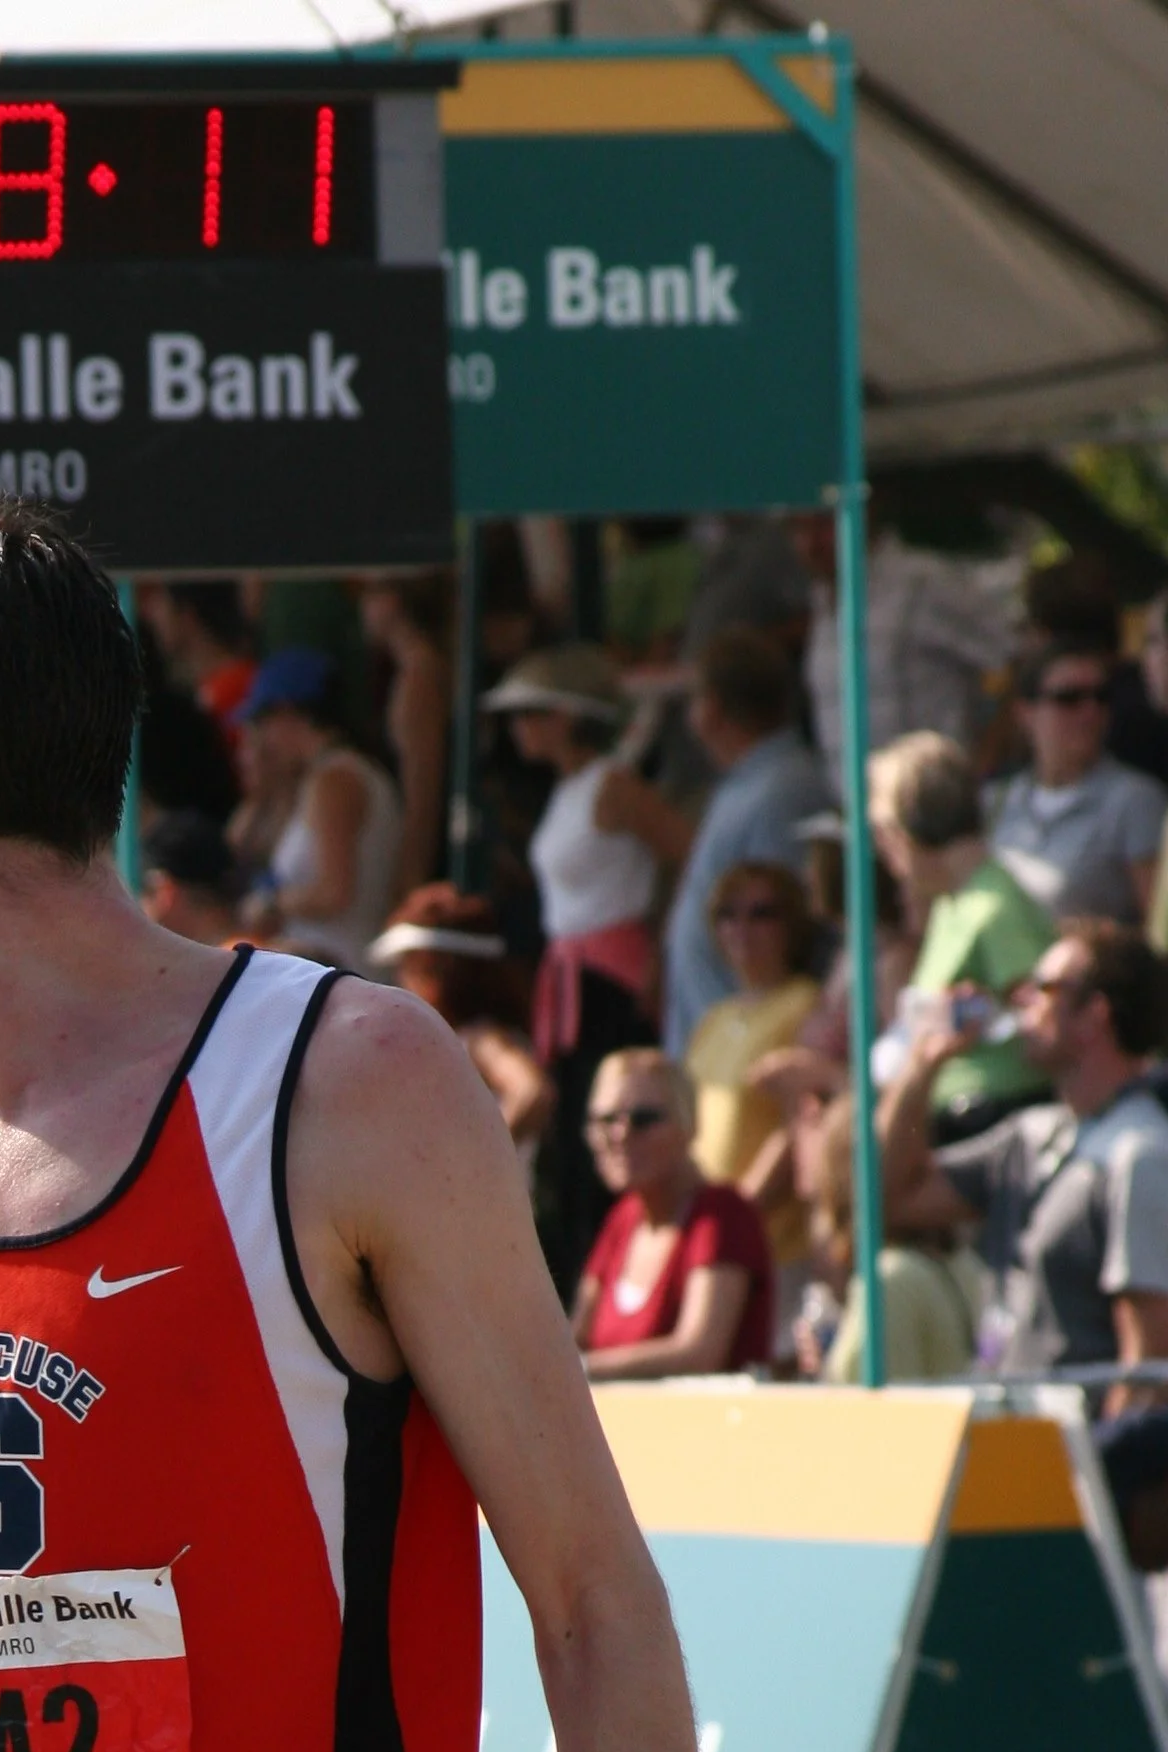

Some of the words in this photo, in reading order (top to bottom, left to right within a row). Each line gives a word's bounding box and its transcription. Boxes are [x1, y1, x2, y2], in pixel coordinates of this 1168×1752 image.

[546, 245, 739, 330] Bank
[148, 331, 362, 420] Bank
[51, 1590, 137, 1623] Bank
